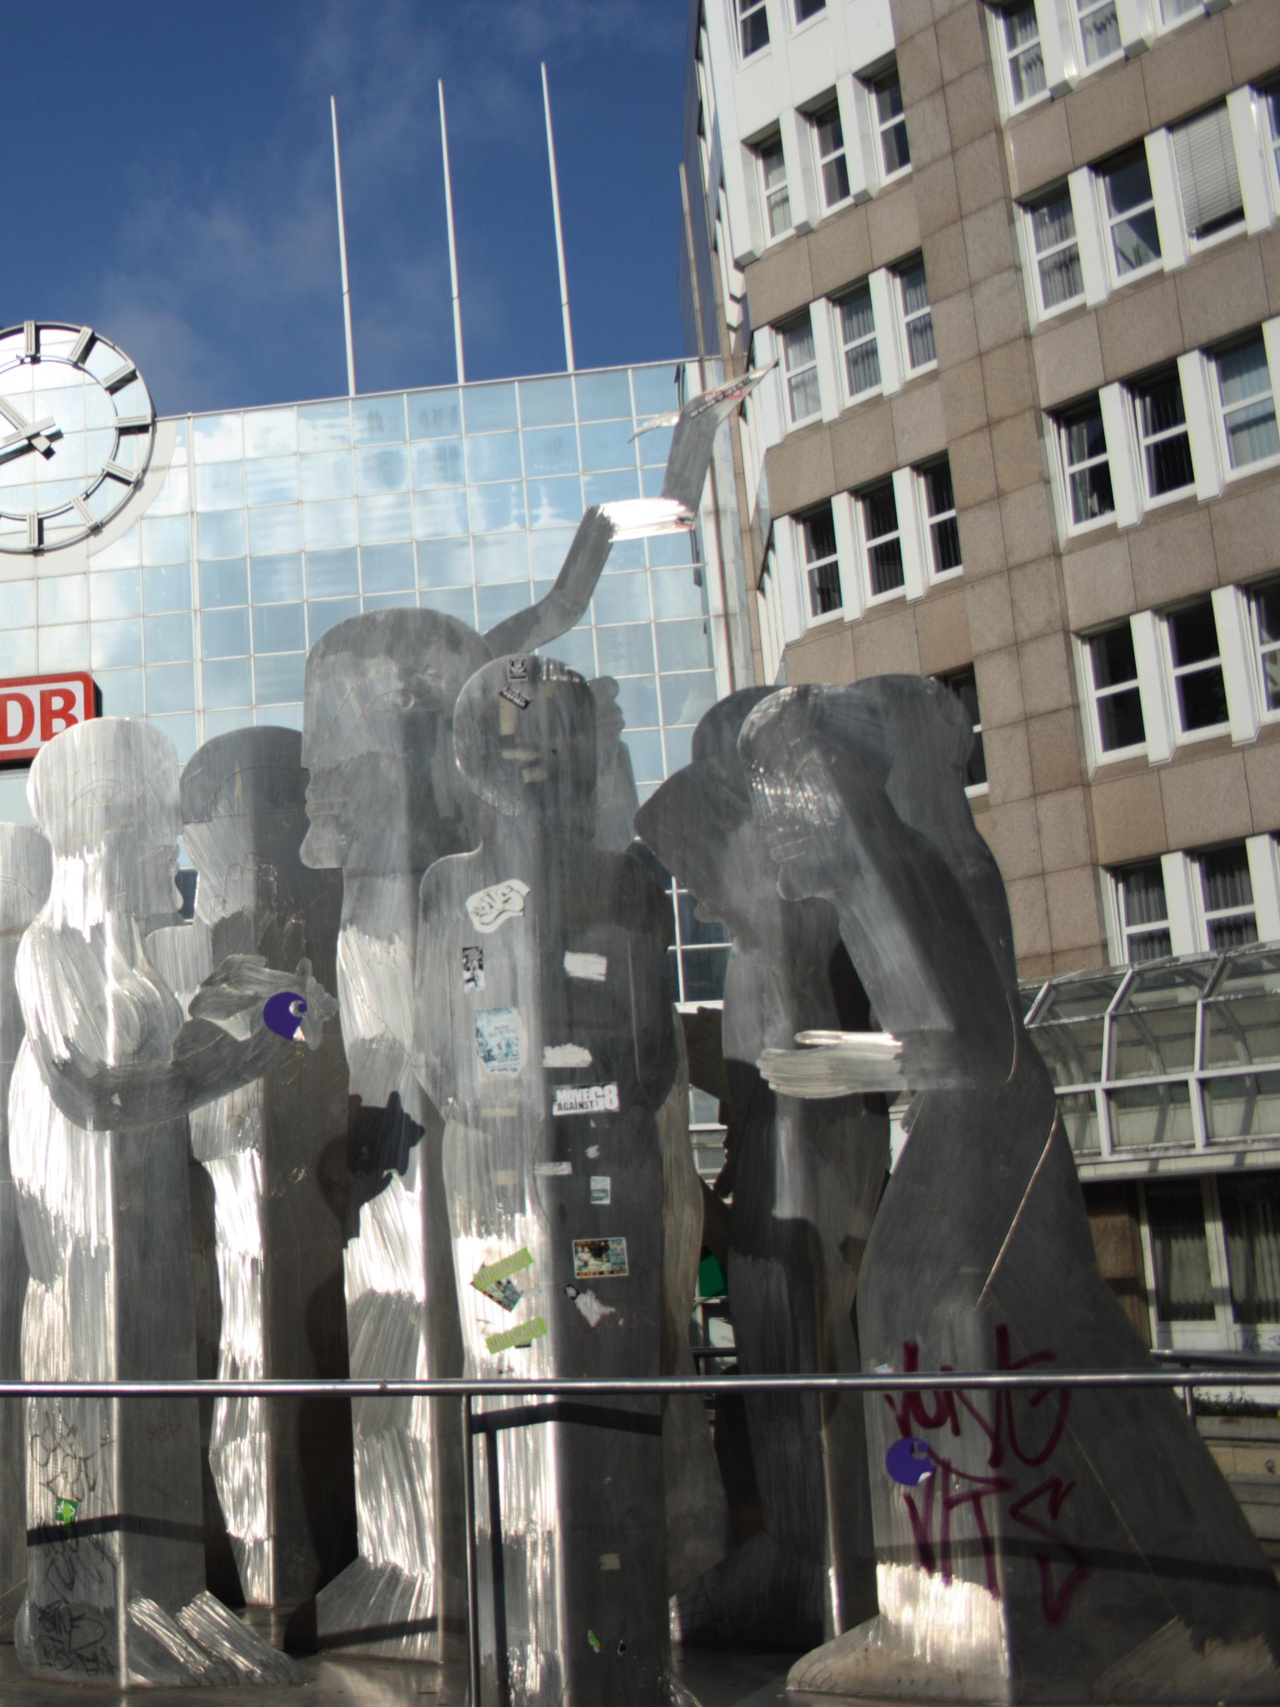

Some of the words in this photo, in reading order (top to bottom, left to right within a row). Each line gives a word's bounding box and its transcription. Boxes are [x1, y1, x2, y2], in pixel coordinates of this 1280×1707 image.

[556, 1088, 592, 1102] MOVE
[590, 1085, 619, 1112] G8
[557, 1101, 594, 1111] AGAINST
